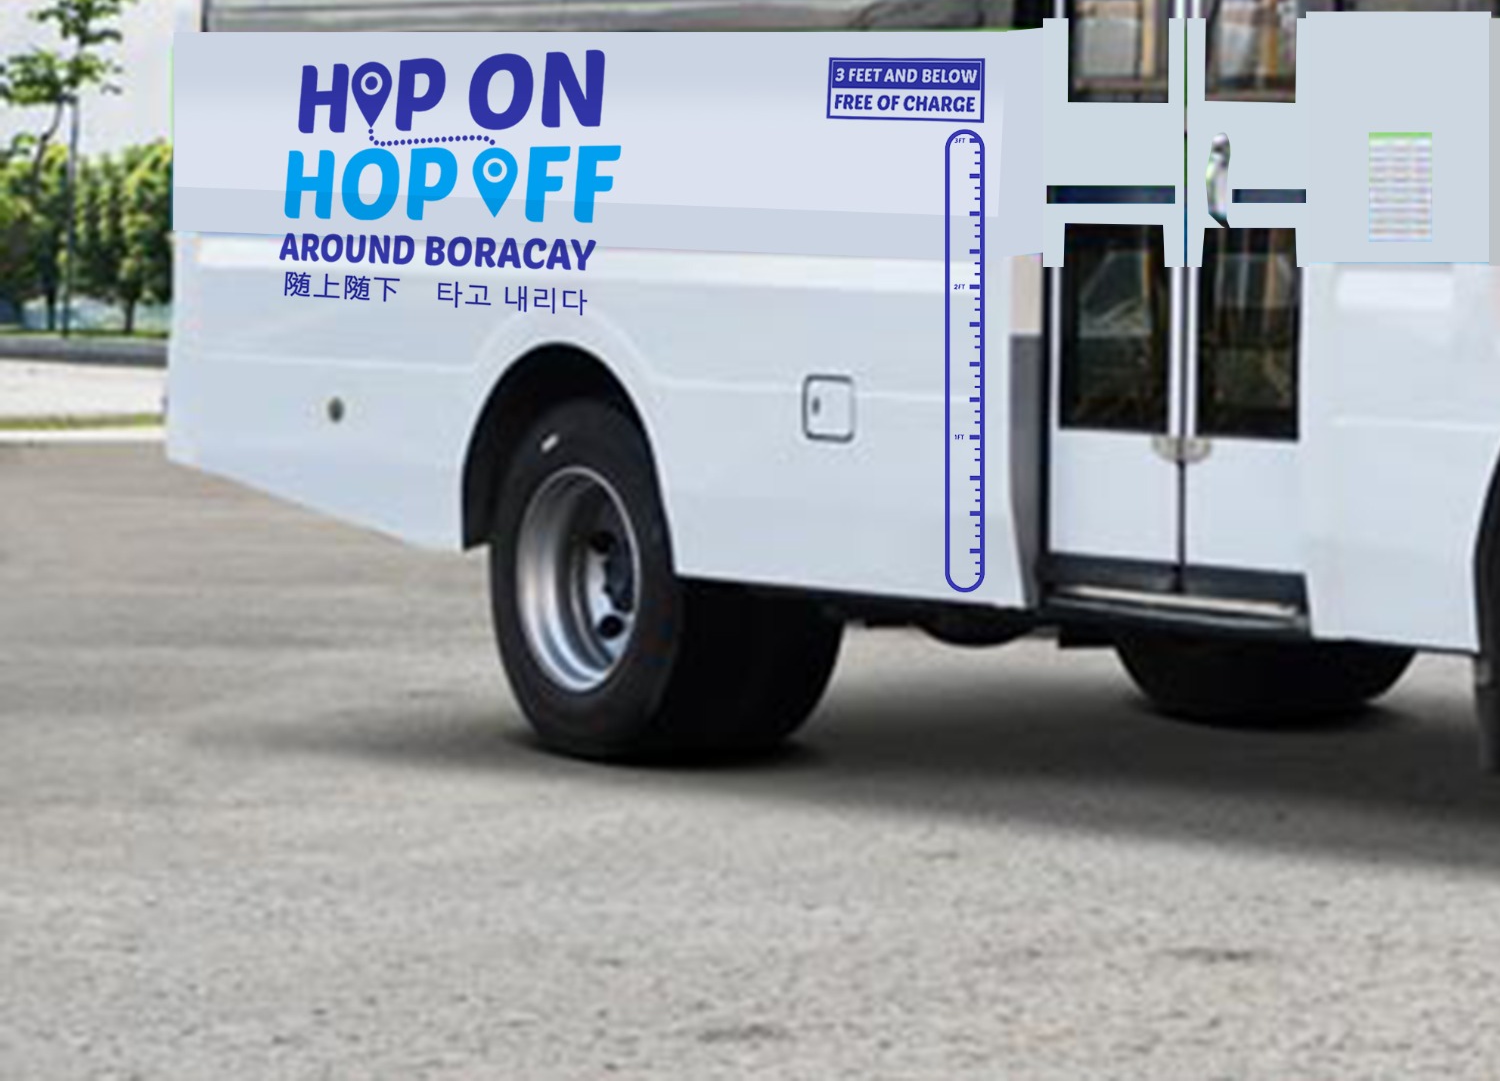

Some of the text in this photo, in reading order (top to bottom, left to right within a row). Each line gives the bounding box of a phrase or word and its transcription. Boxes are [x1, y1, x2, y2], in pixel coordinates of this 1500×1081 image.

[298, 49, 606, 134] HOP ON
[835, 68, 978, 84] 3 FEET AND BELOW
[834, 94, 976, 113] FREE OF CHARGE
[284, 145, 622, 223] HOP OFF
[279, 232, 597, 271] AROUND BORACAY
[437, 281, 588, 316] 타고 내리다
